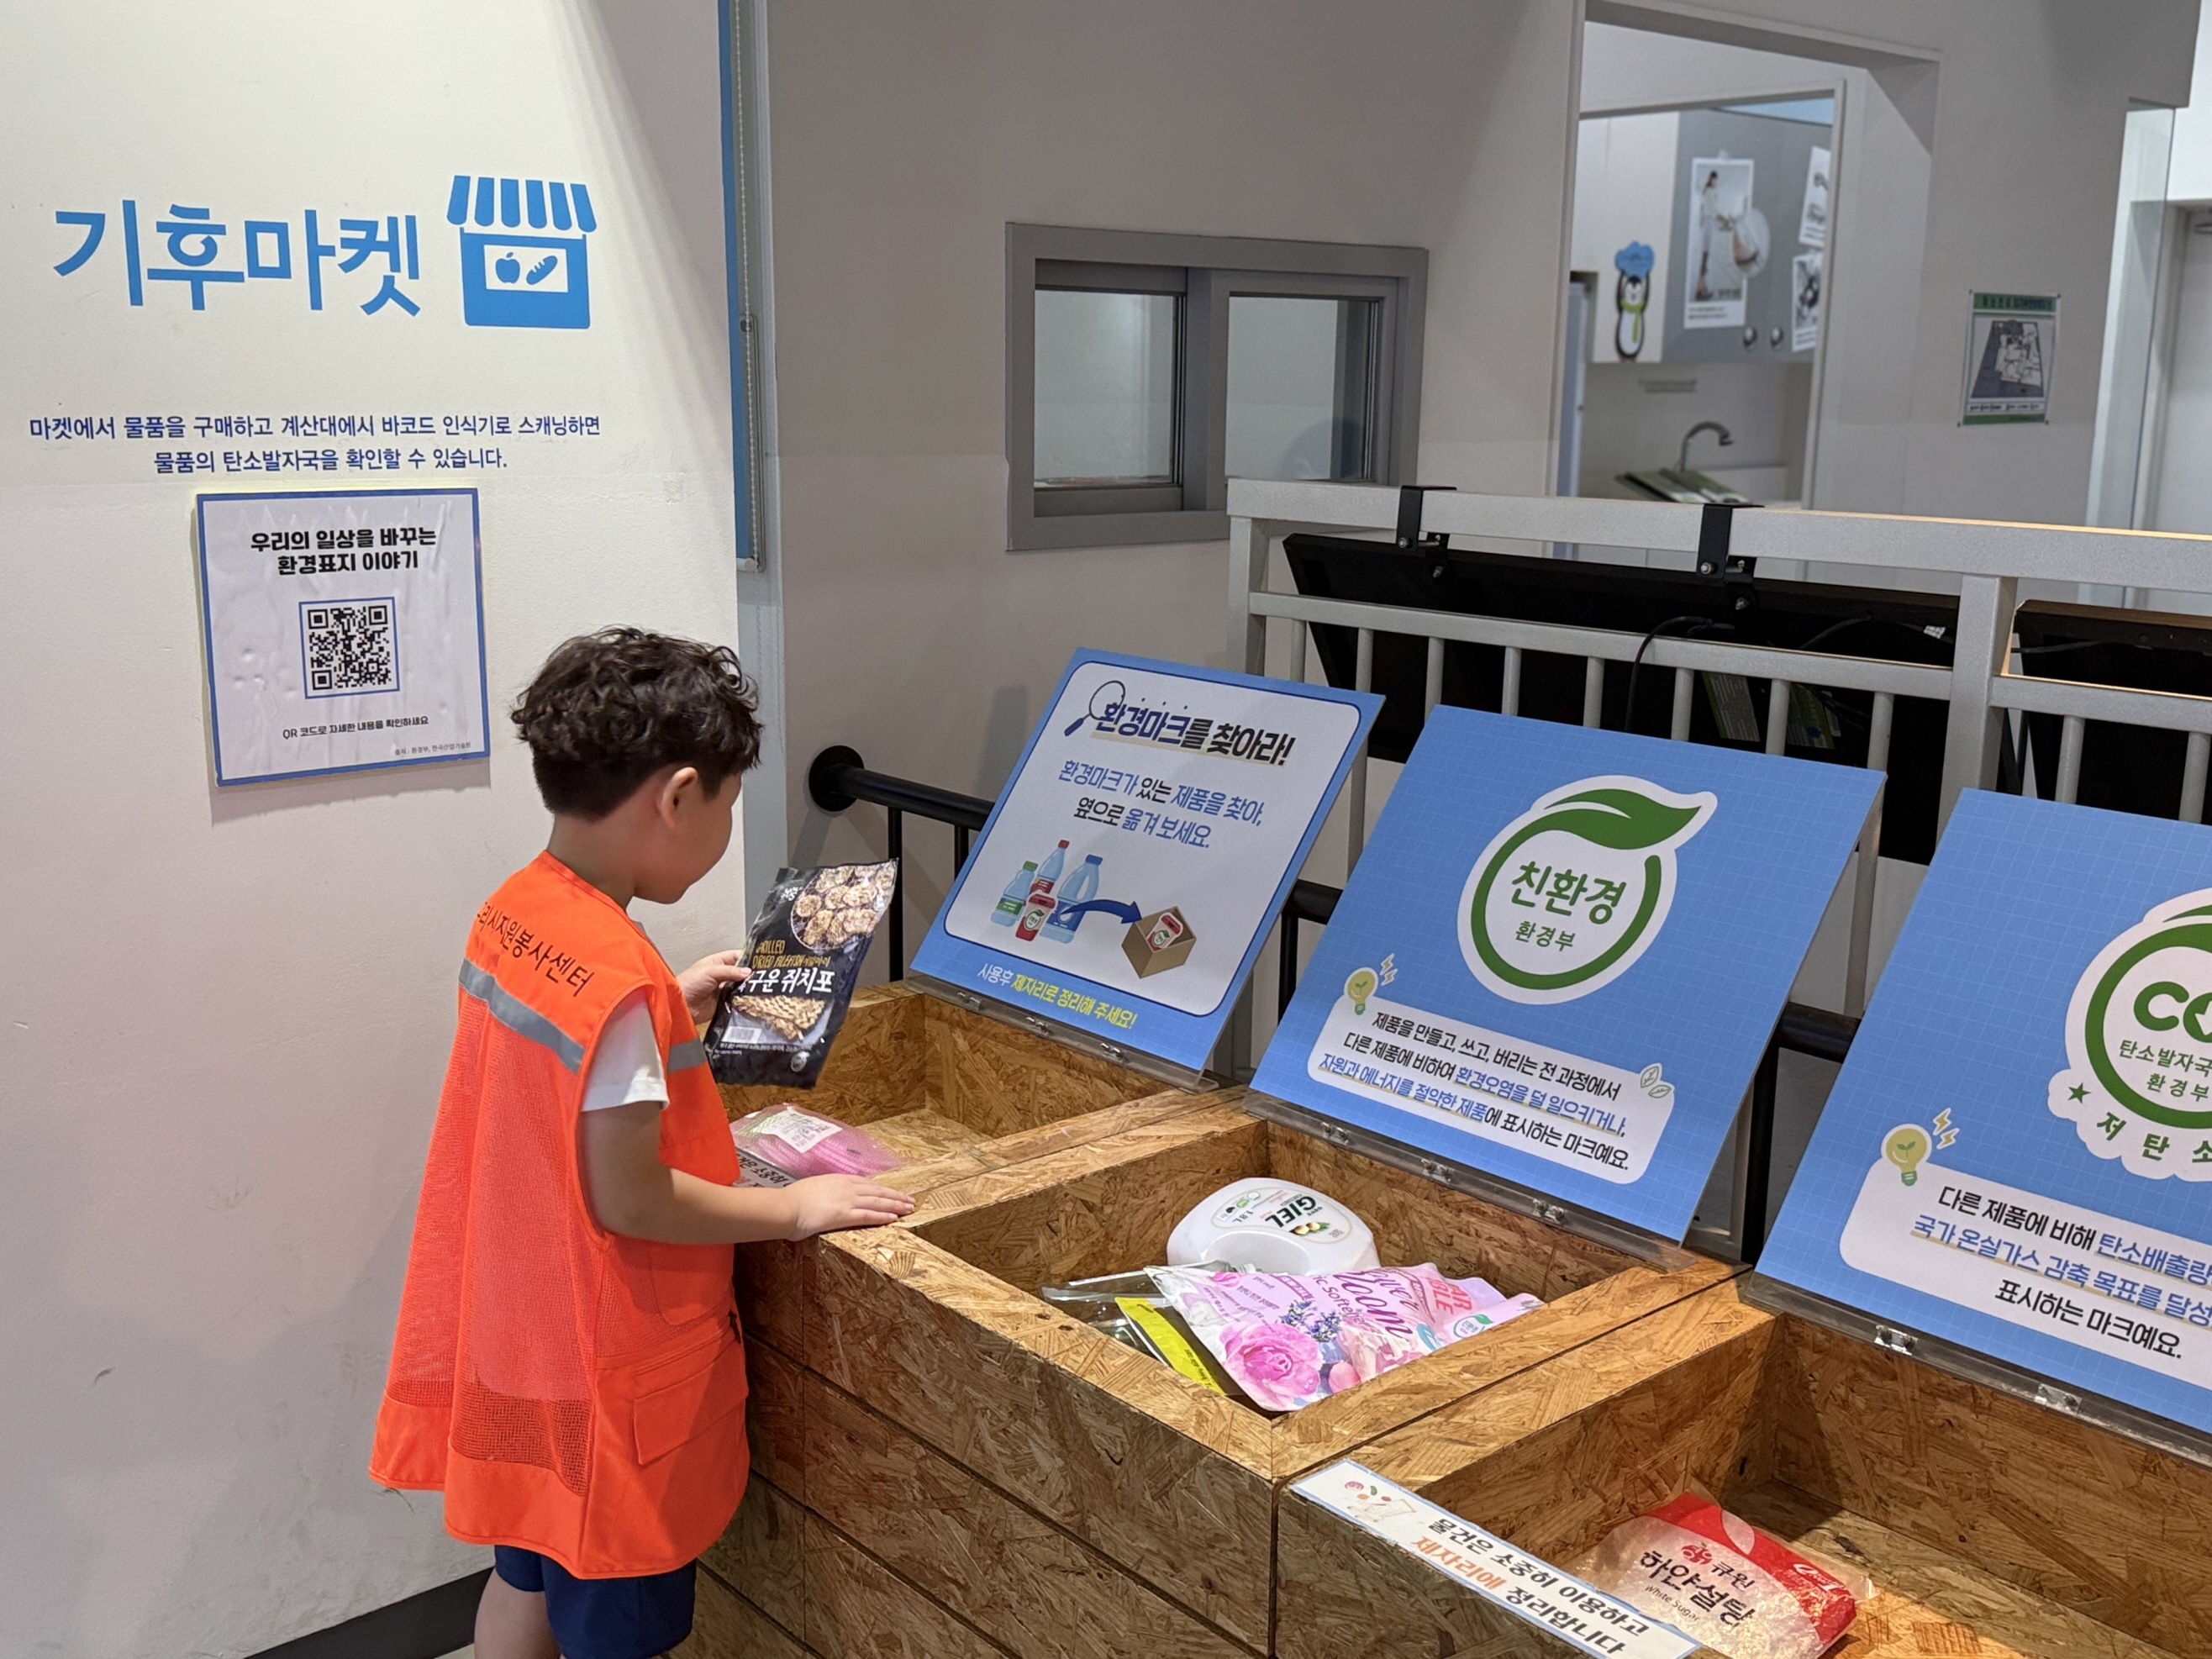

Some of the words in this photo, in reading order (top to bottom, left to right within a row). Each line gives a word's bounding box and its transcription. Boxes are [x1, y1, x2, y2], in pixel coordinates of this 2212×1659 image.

[53, 199, 420, 316] 기후마켓
[29, 417, 115, 440] 마켓에서
[124, 416, 186, 438] 물품을
[193, 415, 273, 438] 구매하고
[382, 415, 435, 436] 바코드
[443, 415, 512, 435] 인식기로
[519, 415, 600, 435] 스캐닝하면
[155, 451, 214, 473] 물품의
[224, 449, 339, 472] 탄소발자국을
[346, 448, 401, 470] 확인할
[408, 449, 426, 469] 수
[434, 448, 507, 468] 있습니다.
[251, 531, 310, 552] 우리의
[316, 529, 374, 549] 일상을
[380, 527, 437, 546] 바꾸는
[277, 553, 356, 576] 환경표지
[363, 550, 419, 571] 이야기
[282, 729, 298, 740] QR
[300, 725, 327, 737] 코드로
[329, 724, 356, 734] 자세한
[357, 720, 383, 730] 내용을
[386, 716, 429, 728] 확인하세요
[1095, 702, 1214, 750] 환경마크를
[1206, 723, 1296, 766] 찾아라!
[1058, 760, 1140, 796] 환경마크가
[1135, 777, 1172, 803] 있는
[1171, 784, 1227, 816] 제품을
[1223, 796, 1265, 826] 찾아,
[1073, 797, 1125, 826] 옆으로
[1121, 808, 1161, 835] 옮겨
[1156, 816, 1212, 848] 보세요.
[1511, 861, 1627, 924] 친환경
[1515, 920, 1576, 952] 환경부
[781, 967, 835, 994] 쥐치포
[977, 963, 1014, 987] 사용후
[1010, 973, 1060, 1003] 제자리로
[1056, 988, 1097, 1016] 정리해
[1094, 1002, 1138, 1030] 주세요!
[1343, 1032, 1372, 1054] 다른
[1370, 1040, 1414, 1067] 제품에
[1412, 1053, 1456, 1081] 비하여
[1454, 1066, 1530, 1103] 환경오염을
[1528, 1089, 1547, 1109] 덜
[1372, 1011, 1414, 1038] 제품을
[1413, 1024, 1457, 1052] 만들고,
[1458, 1038, 1490, 1063] 쓰고,
[1493, 1048, 1538, 1076] 버리는
[1539, 1061, 1557, 1082] 전
[1556, 1066, 1622, 1101] 과정에서
[2119, 1039, 2212, 1077] 탄소발자국
[2146, 1072, 2209, 1103] 환경부
[1319, 1053, 1361, 1079] 자원과
[1359, 1066, 1414, 1098] 에너지를
[1413, 1082, 1457, 1111] 절약한
[1456, 1098, 1503, 1127] 제품에
[1500, 1113, 1562, 1148] 표시하는
[1563, 1133, 1629, 1170] 마크예요.
[1265, 1196, 1316, 1228] GIEL
[1938, 1186, 1982, 1216] 다른
[1982, 1199, 2049, 1236] 제품에
[2049, 1219, 2097, 1251] 비해
[1914, 1214, 1956, 1245] 국가
[1957, 1228, 2040, 1272] 온실가스
[2044, 1255, 2091, 1288] 감축
[2094, 1271, 2162, 1311] 목표를
[1994, 1279, 2083, 1326] 표시하는
[2086, 1309, 2183, 1359] 마크예요.
[1411, 1536, 1507, 1591] 제자리에
[1505, 1586, 1625, 1654] 정리합니다
[1428, 1518, 1494, 1555] 물건은
[1490, 1554, 1559, 1588] 소중히
[1559, 1586, 1650, 1636] 이용하고
[1640, 1550, 1756, 1627] 하얀설탕
[1645, 1584, 1672, 1605] White
[1672, 1599, 1700, 1622] Sugar
[1713, 1561, 1756, 1592] 큐원
